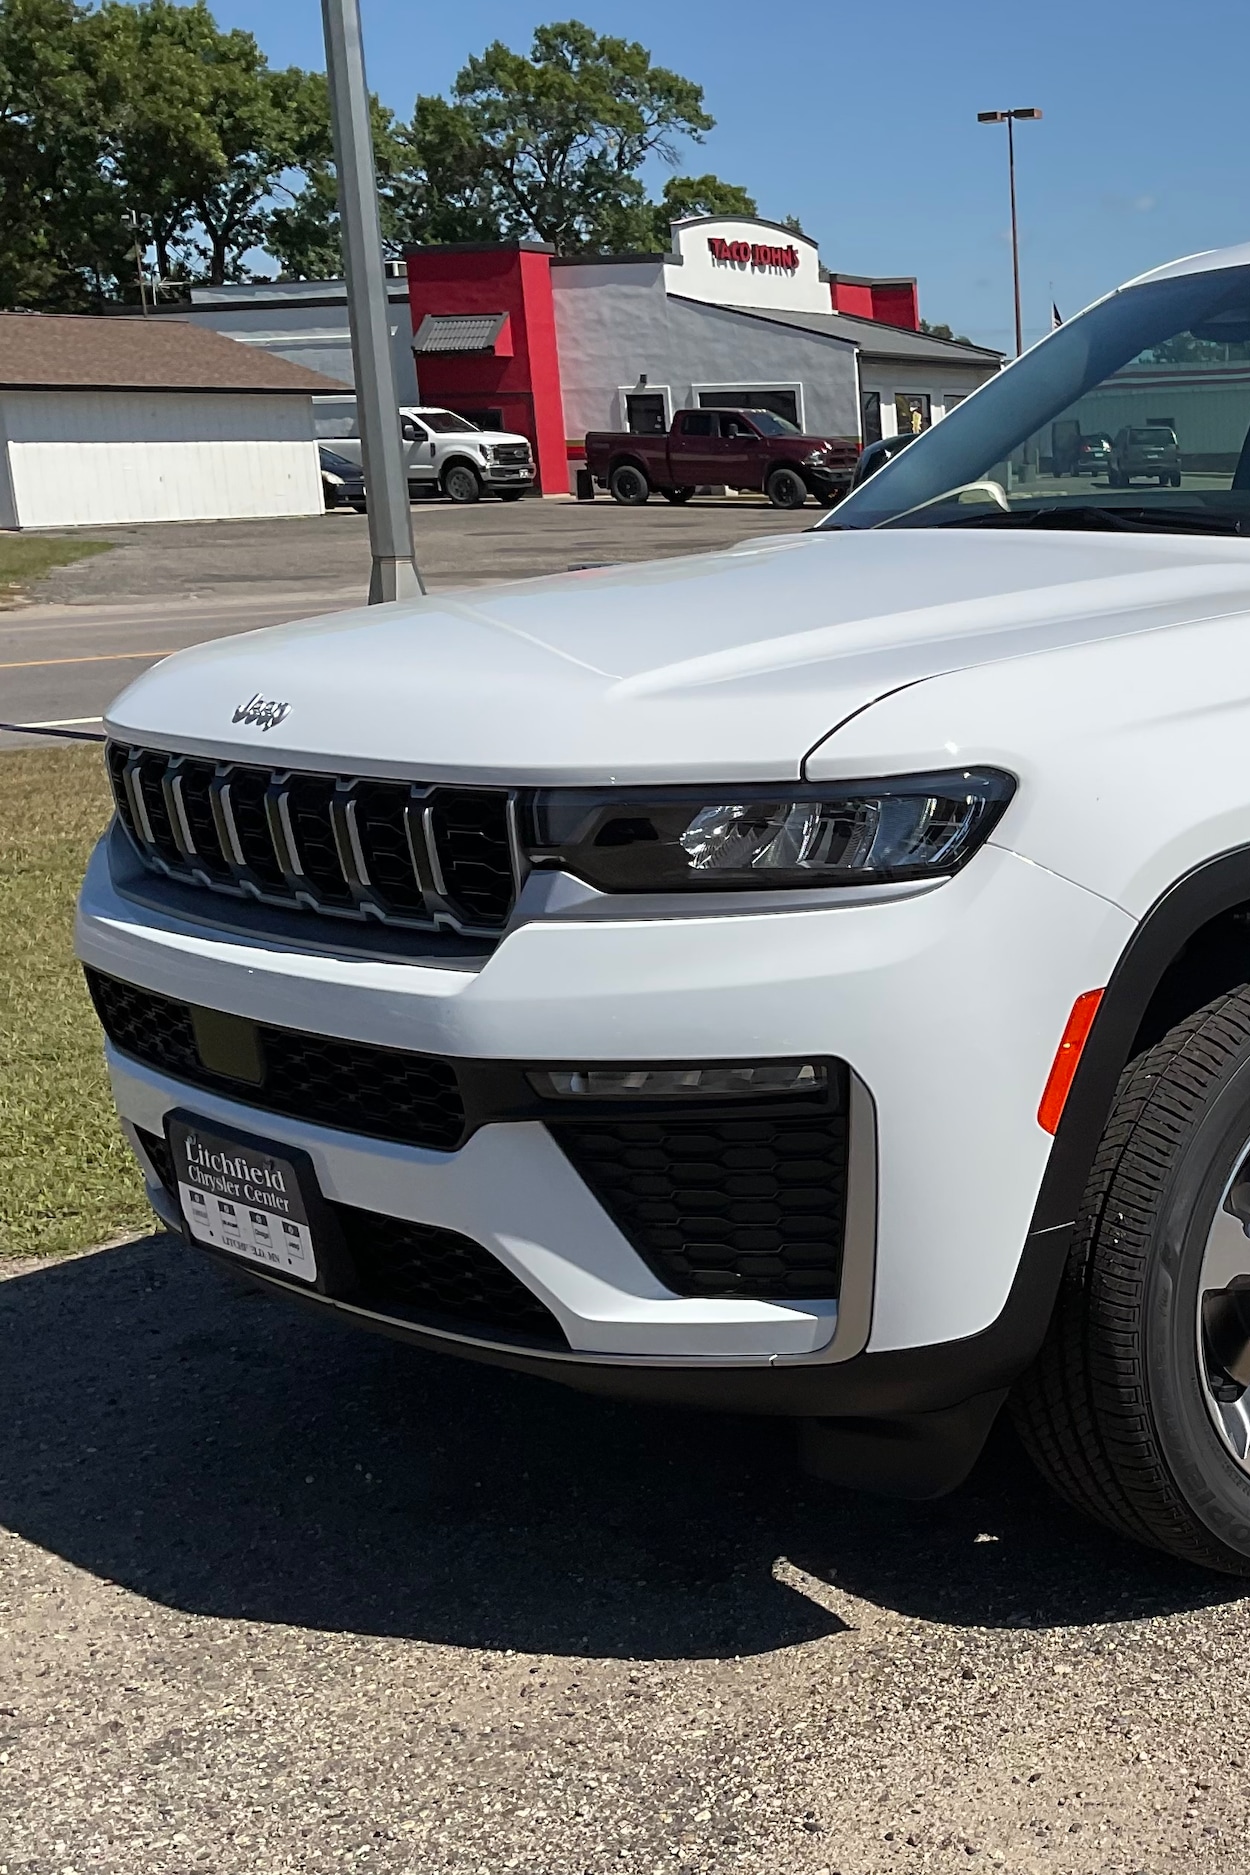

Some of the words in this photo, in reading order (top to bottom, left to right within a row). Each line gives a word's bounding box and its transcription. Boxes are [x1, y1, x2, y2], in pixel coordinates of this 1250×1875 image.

[707, 238, 751, 262] TACO
[231, 692, 292, 732] Jeep
[185, 1138, 286, 1193] Litchfield
[188, 1165, 240, 1197] Chrysler
[244, 1185, 289, 1213] Center
